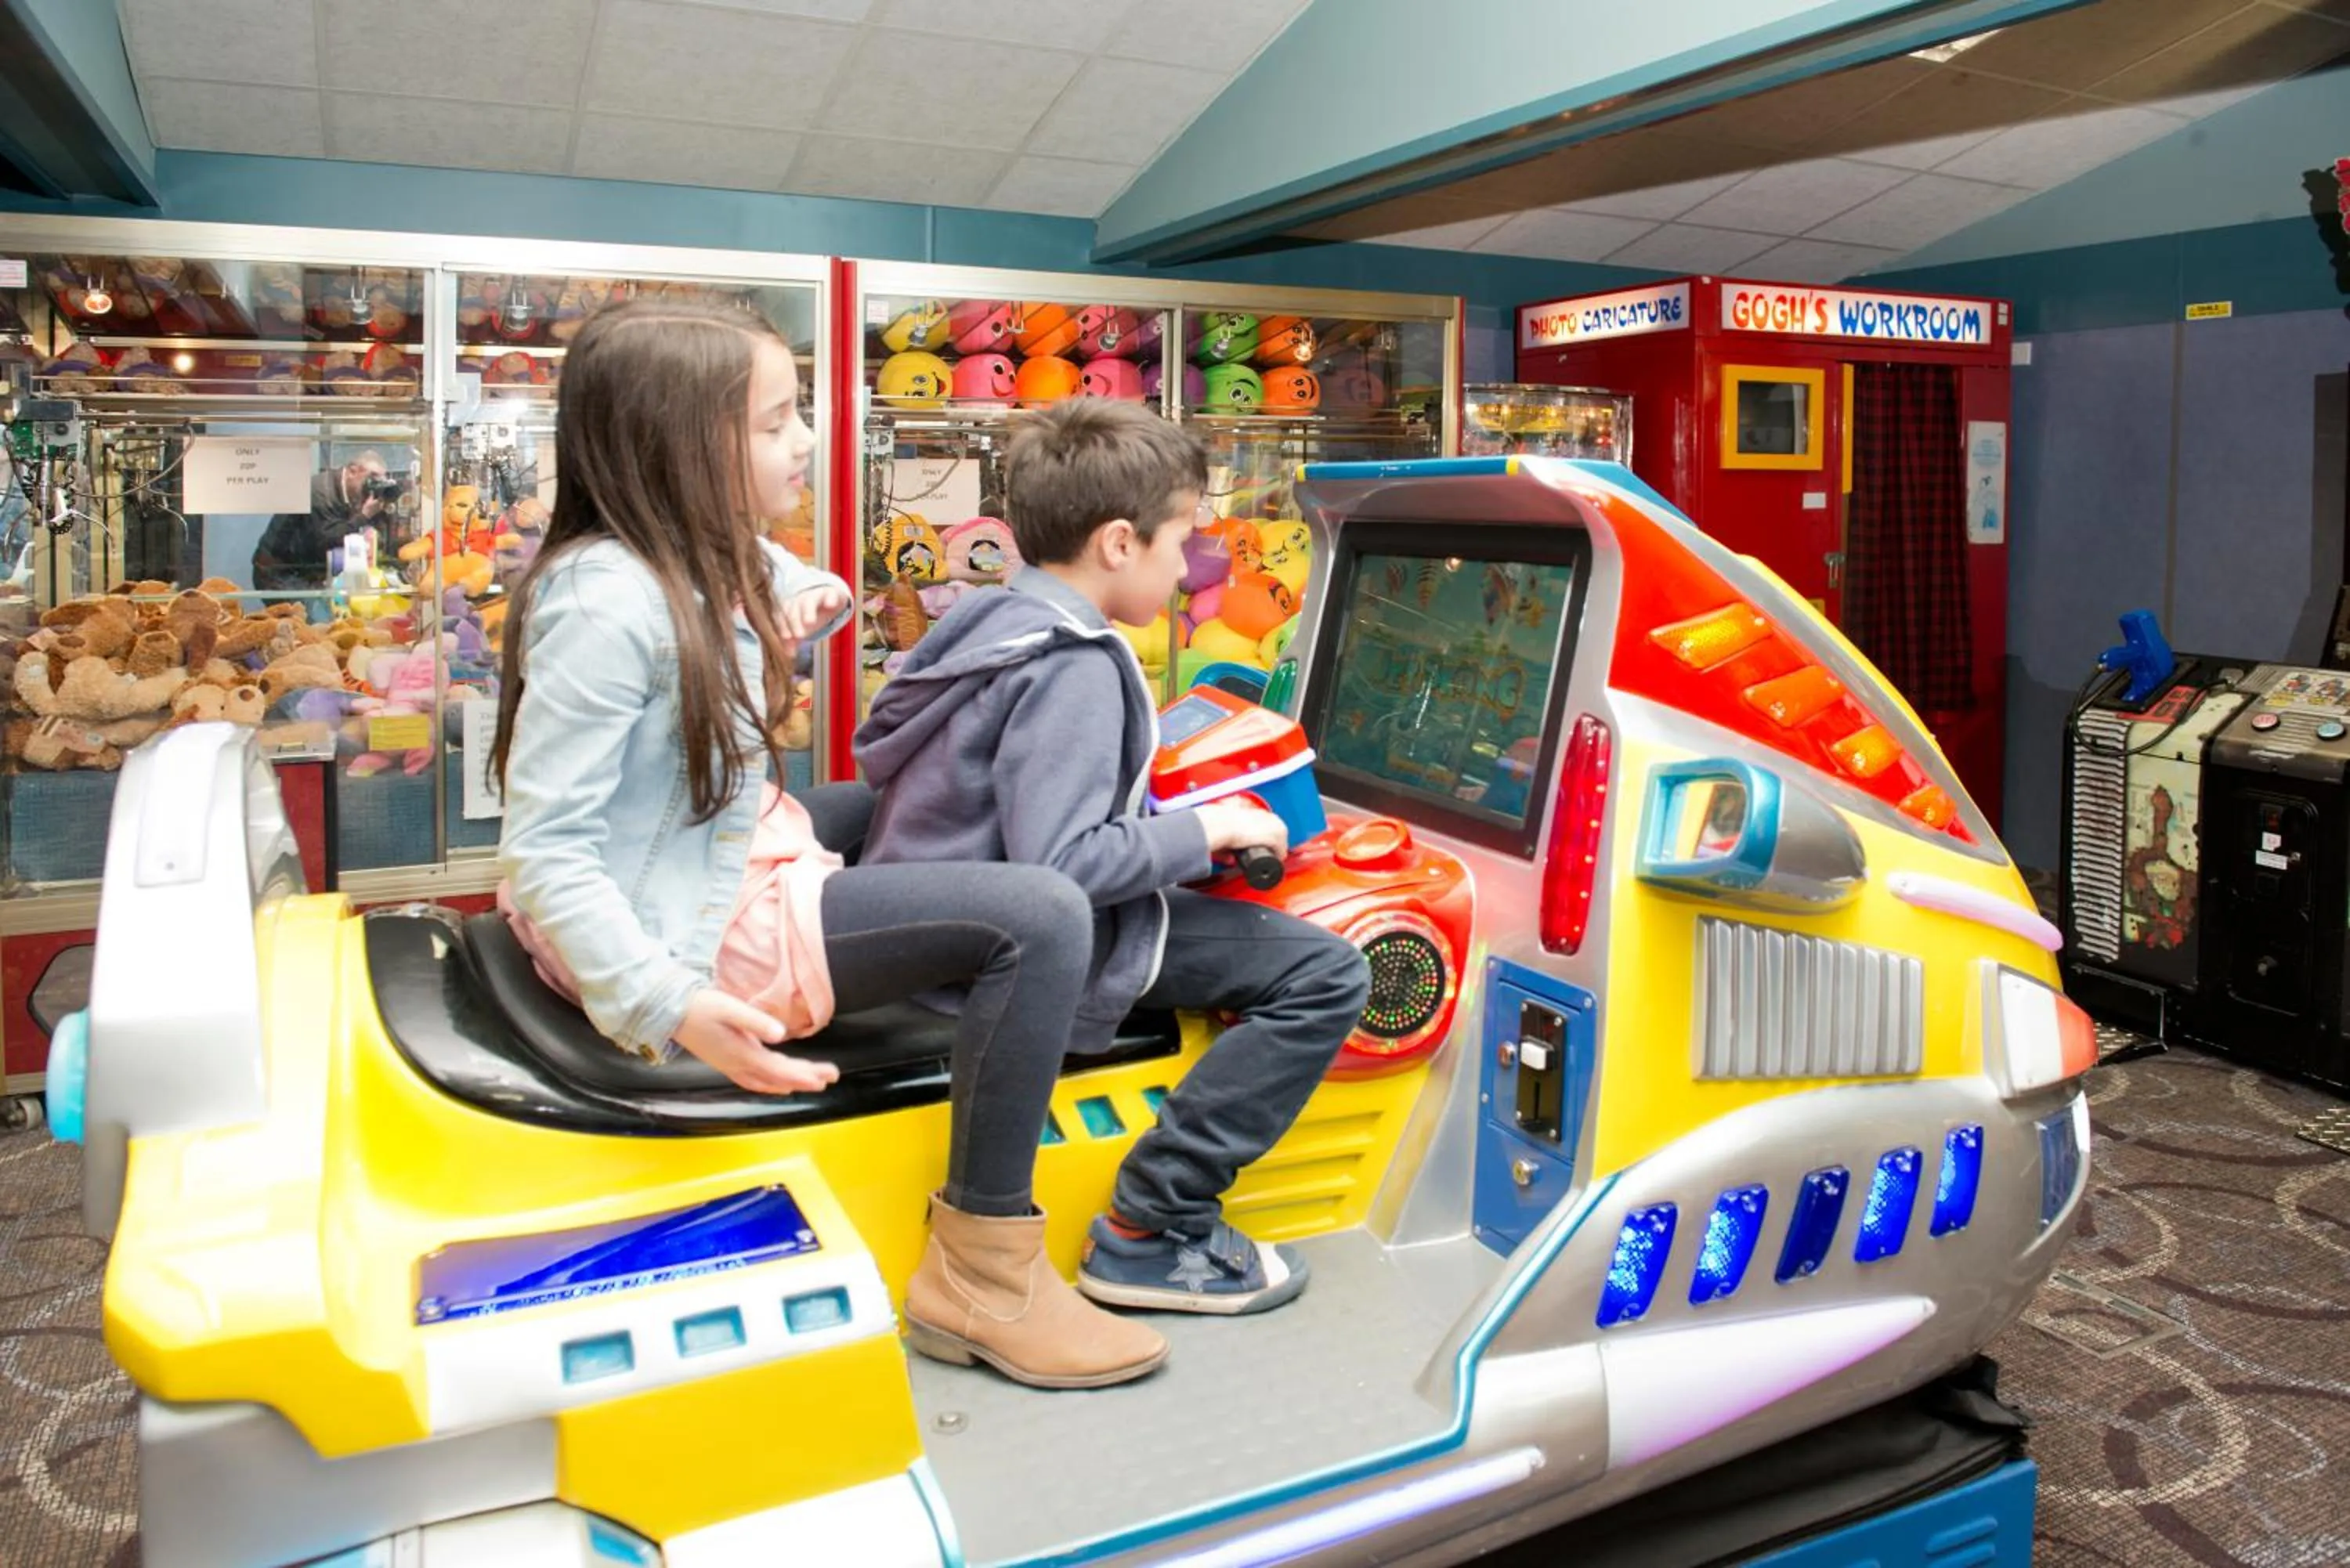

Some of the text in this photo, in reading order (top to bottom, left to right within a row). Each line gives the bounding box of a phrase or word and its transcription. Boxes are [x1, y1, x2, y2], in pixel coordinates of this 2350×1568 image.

[1529, 295, 1683, 340] PHOTO CARICATURE
[1732, 290, 1981, 342] GOGH'S WORKROOM
[235, 447, 260, 456] ONLY
[226, 476, 269, 485] PER PLAY
